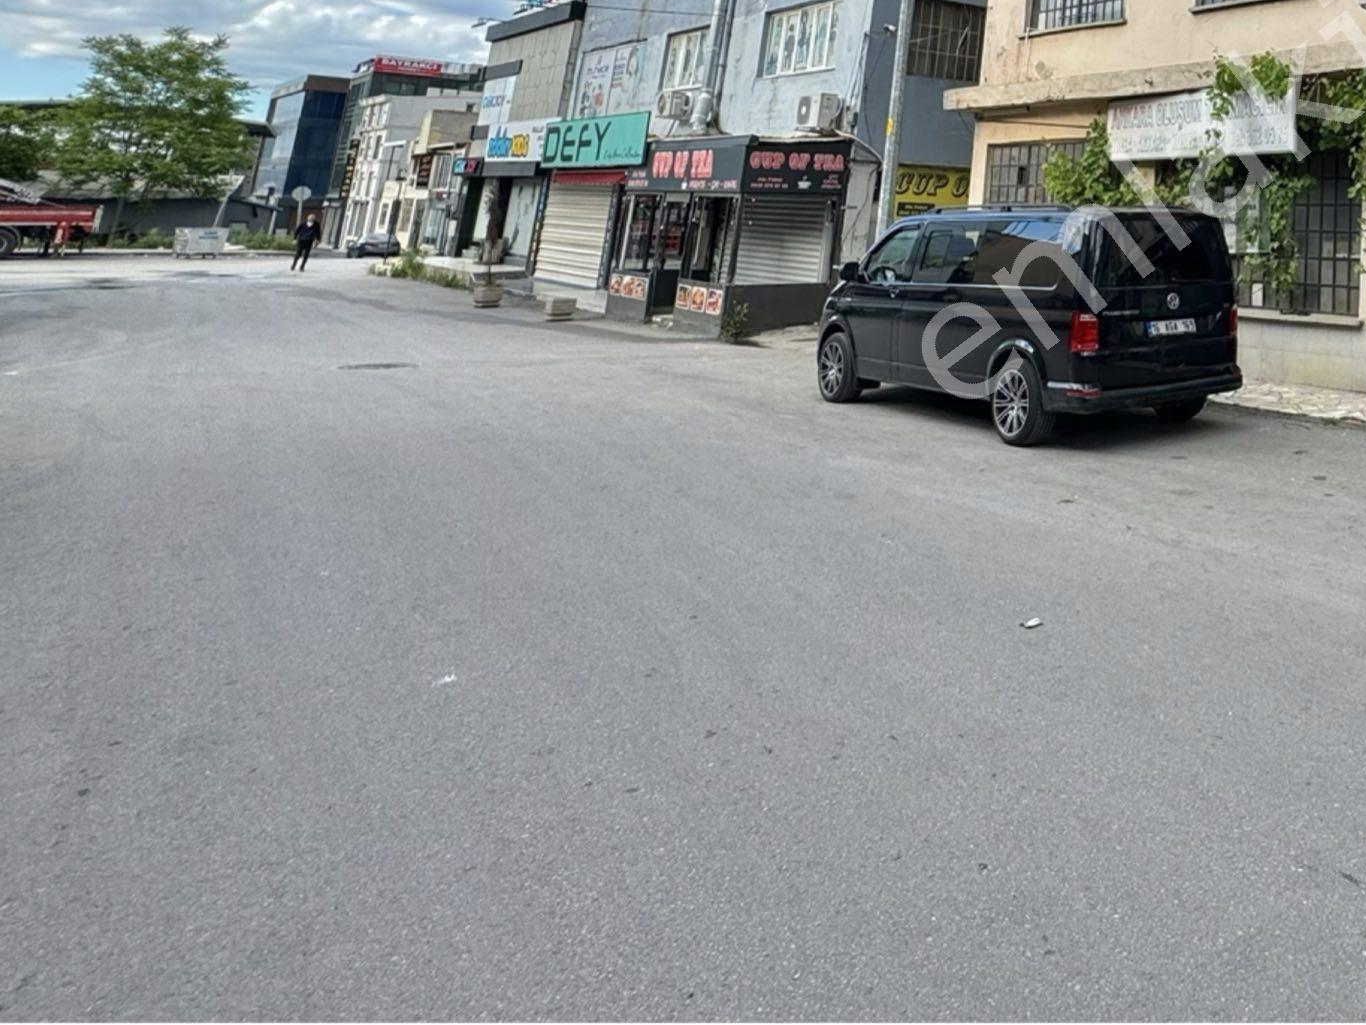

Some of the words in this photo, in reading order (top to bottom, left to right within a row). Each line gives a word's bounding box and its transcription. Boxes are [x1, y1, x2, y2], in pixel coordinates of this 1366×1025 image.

[1110, 103, 1153, 130] ANKARA
[542, 121, 612, 164] DEFY
[750, 150, 786, 170] CUP
[788, 152, 811, 171] OF
[813, 153, 845, 172] TEA
[895, 171, 949, 196] CUP
